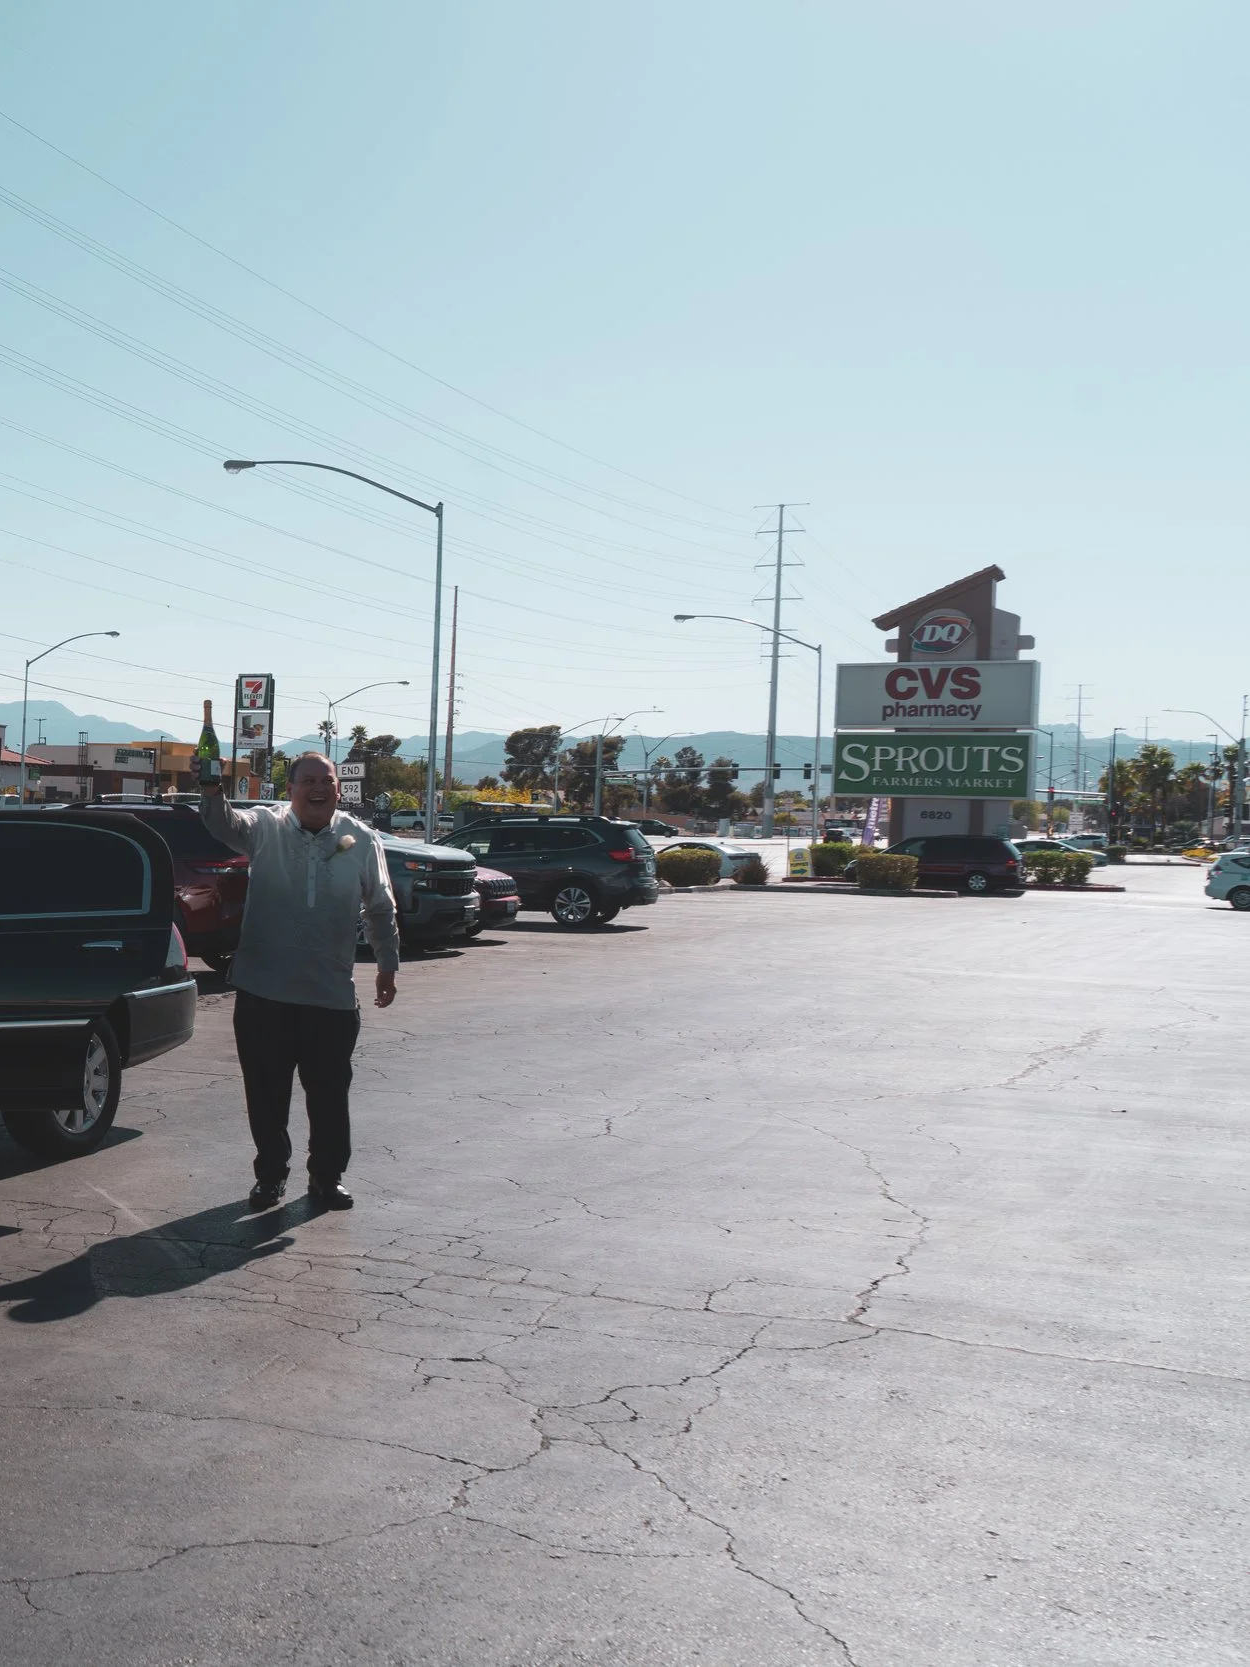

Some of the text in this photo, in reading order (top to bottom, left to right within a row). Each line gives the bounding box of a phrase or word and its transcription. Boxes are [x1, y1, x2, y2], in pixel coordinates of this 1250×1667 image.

[921, 624, 963, 645] DQ
[884, 666, 981, 700] CVS
[882, 702, 982, 720] pharmacy
[838, 743, 1025, 782] SPROUTS
[341, 766, 360, 775] END
[344, 784, 359, 793] 592
[871, 776, 1017, 789] FARMERS MARKET
[920, 810, 952, 820] 6820
